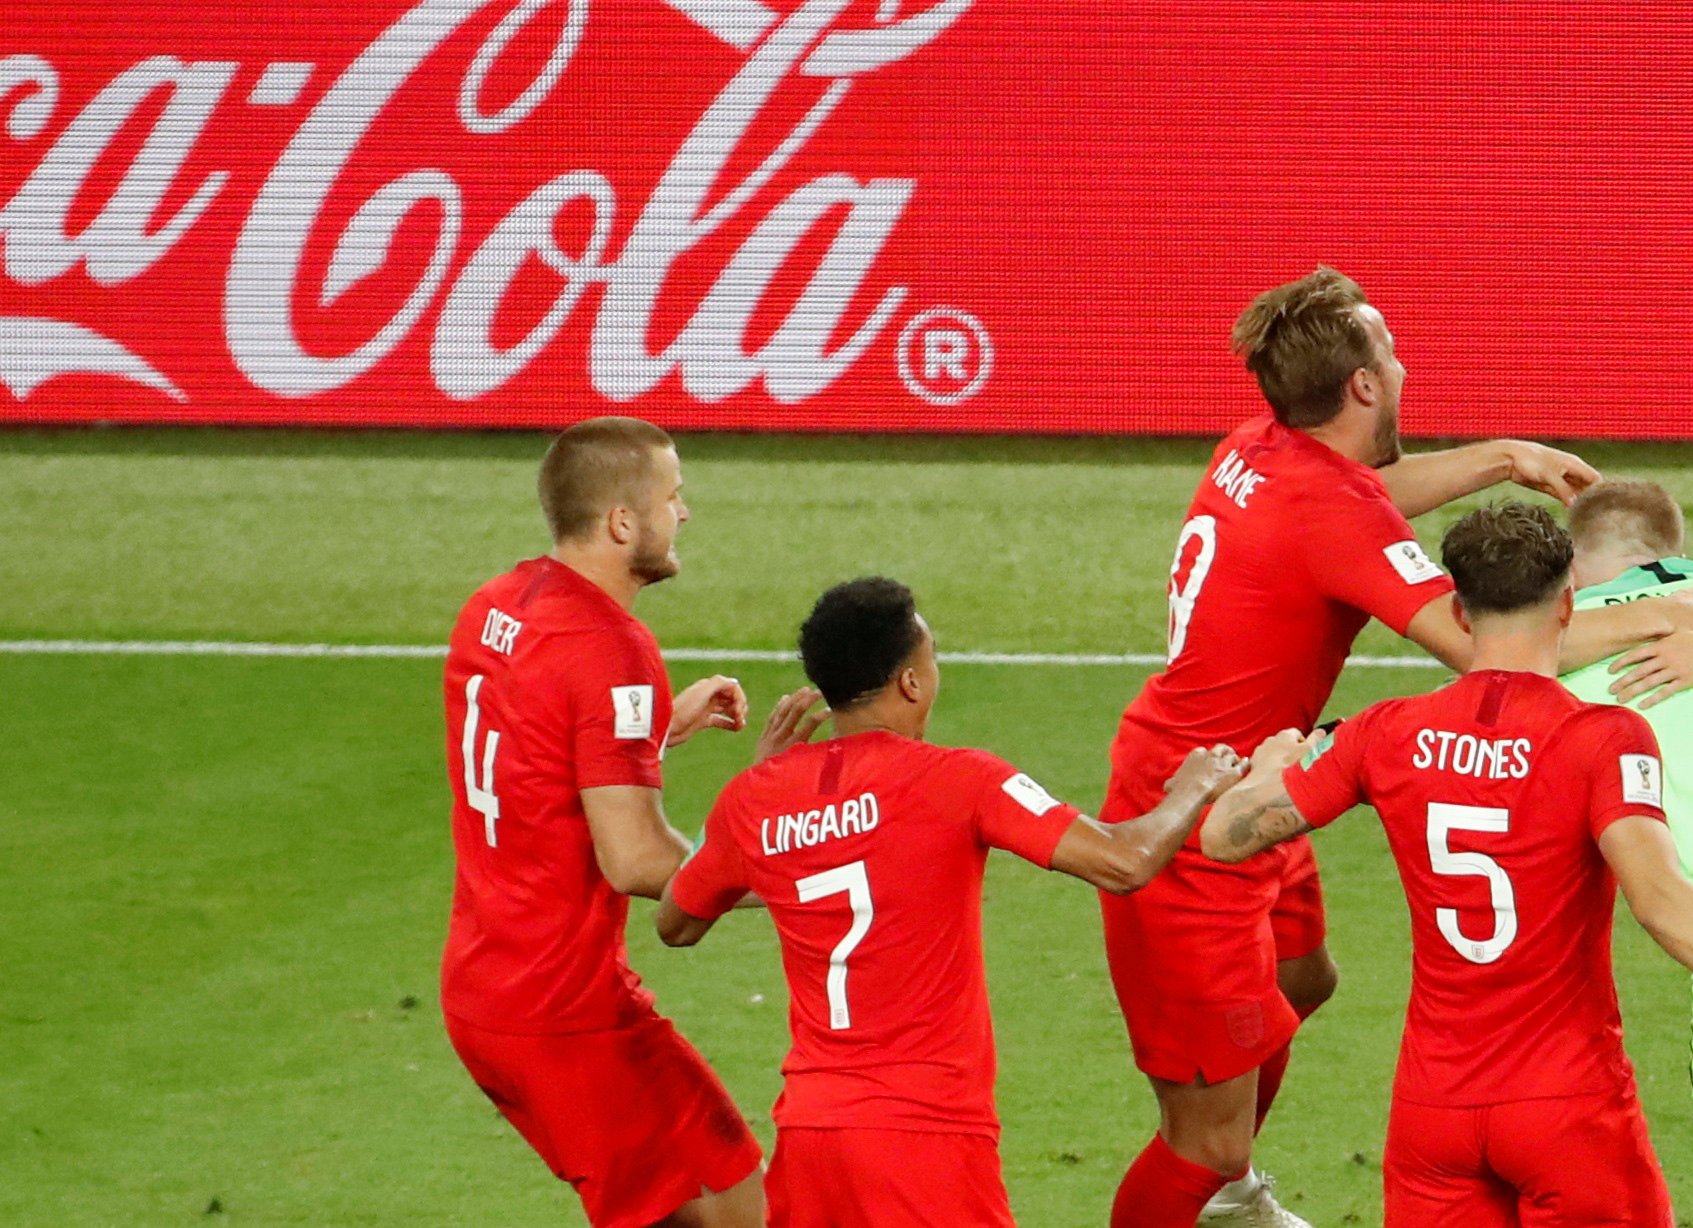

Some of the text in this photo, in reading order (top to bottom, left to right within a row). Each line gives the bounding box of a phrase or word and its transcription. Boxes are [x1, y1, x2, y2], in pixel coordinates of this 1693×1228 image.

[1212, 448, 1266, 509] KANE
[461, 673, 501, 848] 4
[1412, 728, 1532, 780] STONES
[760, 791, 880, 857] LINGARD
[1425, 801, 1519, 965] 5
[794, 860, 875, 1031] 7
